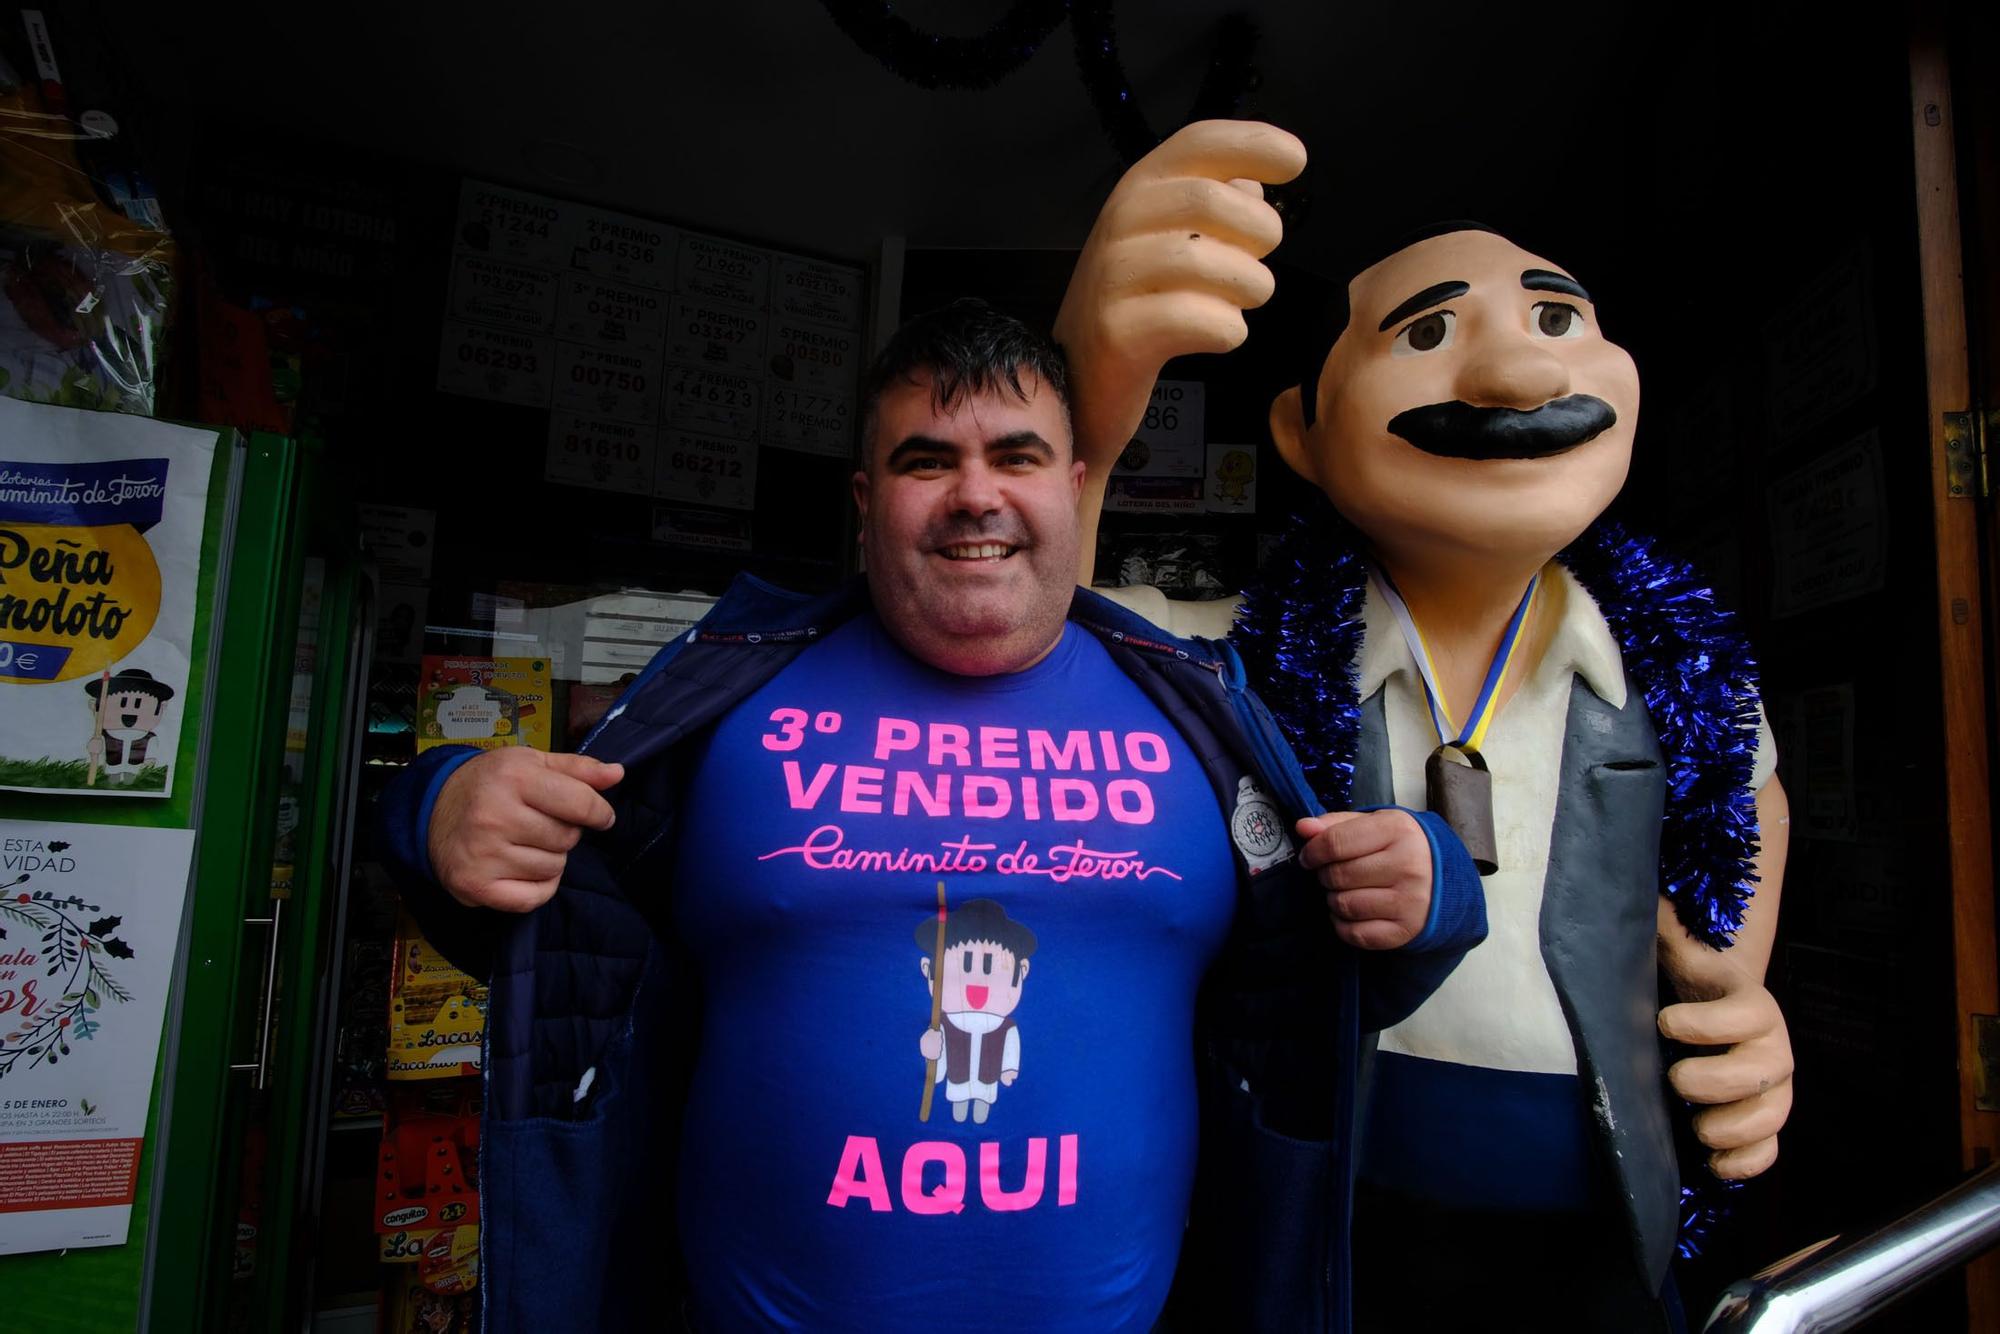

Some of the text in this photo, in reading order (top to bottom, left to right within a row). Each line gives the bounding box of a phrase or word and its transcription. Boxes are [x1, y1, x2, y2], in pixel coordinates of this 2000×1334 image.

[489, 195, 558, 221] PREMIO
[481, 209, 549, 239] 51244
[601, 223, 661, 246] PREMIO
[590, 236, 654, 263] 04536
[596, 288, 657, 309] PREMIO
[588, 301, 641, 322] 04211
[697, 310, 757, 331] PREMIO
[485, 331, 533, 350] PREMIO
[689, 322, 745, 343] 03347
[458, 342, 537, 373] 06293
[597, 351, 642, 369] PREMIO
[785, 343, 842, 367] 00580
[571, 365, 646, 392] 00750
[699, 372, 748, 390] PREMIO
[673, 381, 752, 409] 44623
[774, 390, 847, 416] 61776
[591, 422, 636, 438] PREMIO
[790, 411, 842, 432] PREMIO
[1145, 406, 1178, 430] 86
[564, 435, 641, 462] 81610
[695, 439, 738, 455] PREMIO
[672, 451, 743, 478] 66212
[82, 480, 110, 504] de
[762, 708, 1171, 773] 3º PREMIO
[782, 760, 1156, 824] VENDIDO
[4, 839, 44, 852] ESTA
[758, 825, 1182, 883] Caminito de Teror
[4, 855, 75, 873] VIDAD
[4, 1099, 68, 1109] 5 DE ENERO
[826, 1134, 1078, 1215] AQUI
